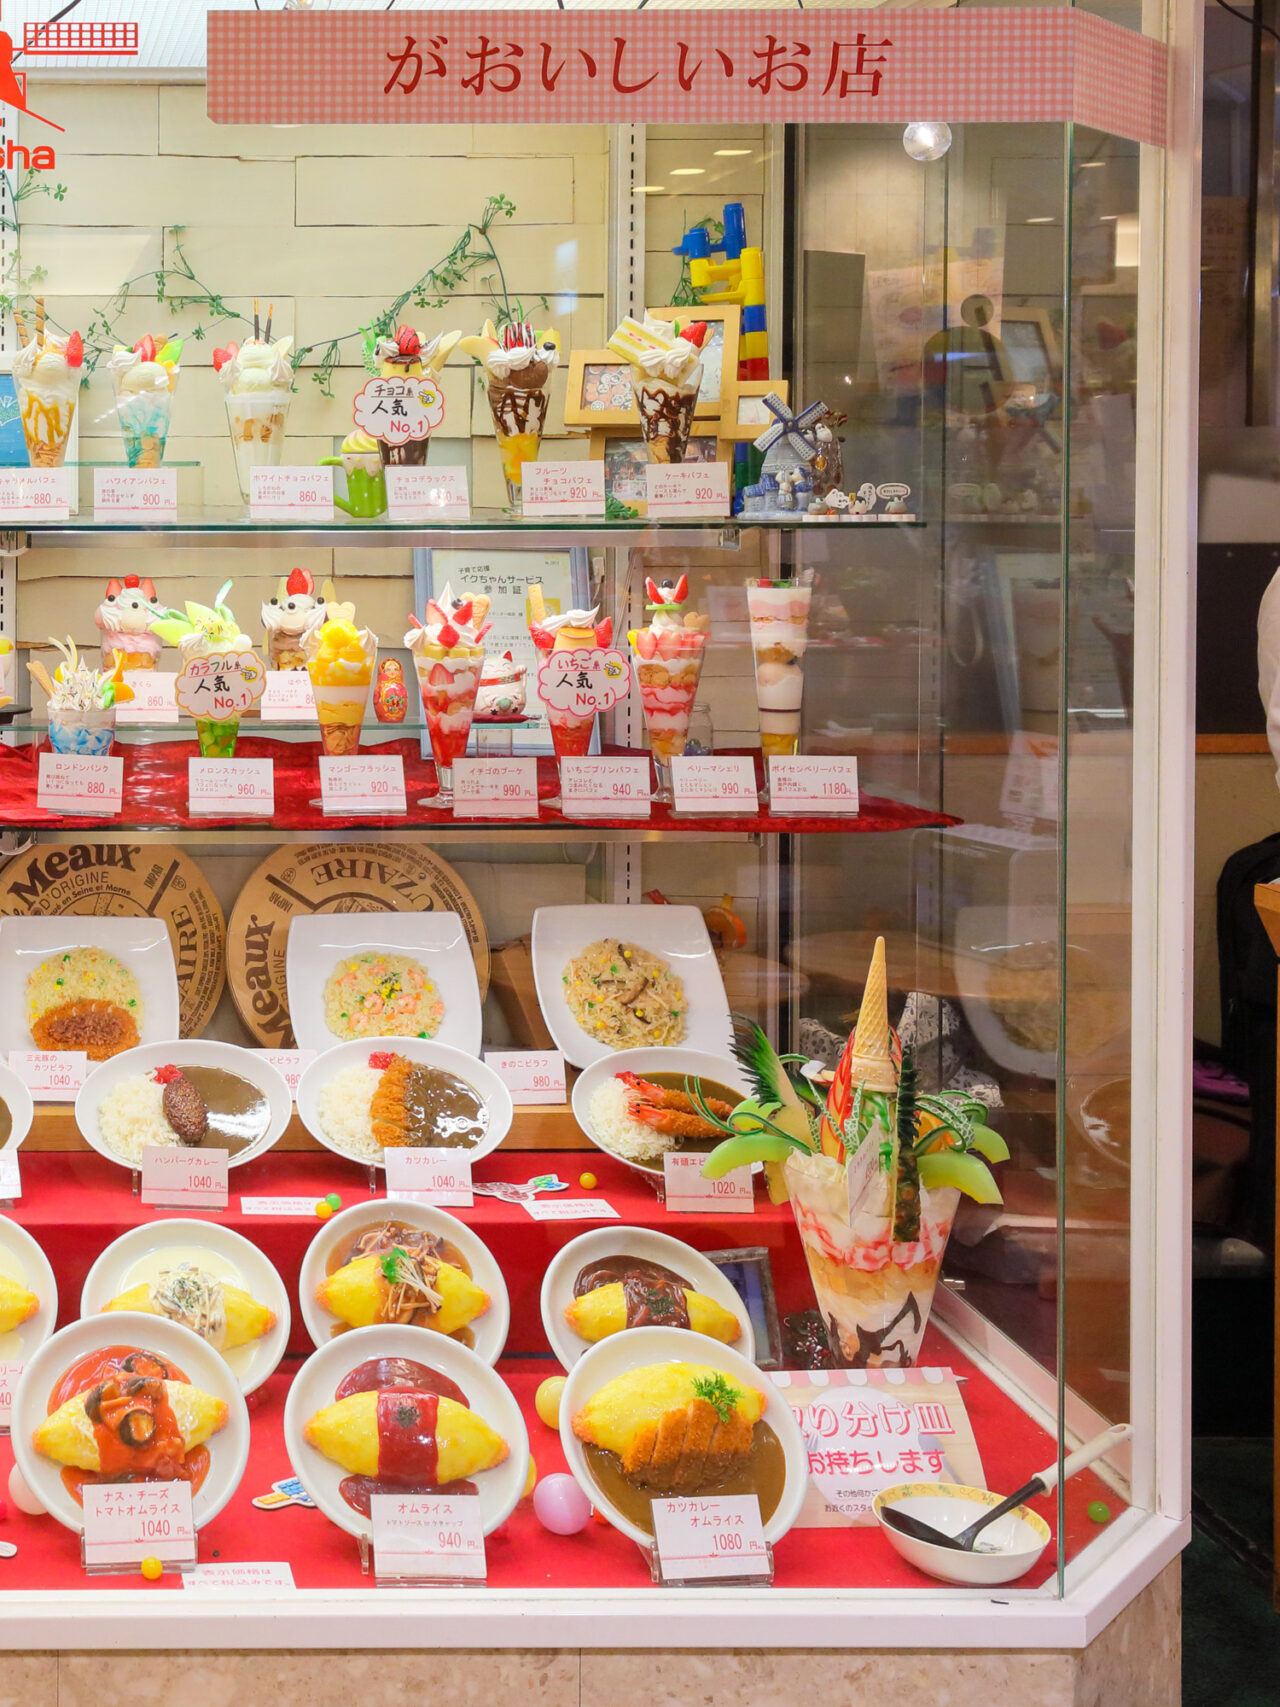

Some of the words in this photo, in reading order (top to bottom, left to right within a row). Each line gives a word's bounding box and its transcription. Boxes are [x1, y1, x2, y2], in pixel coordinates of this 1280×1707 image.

[383, 33, 893, 98] がおいしいお店
[371, 398, 409, 417] 人気
[389, 419, 424, 434] No.1
[535, 467, 567, 475] フルーツ
[665, 472, 709, 480] ケーキパフェ
[105, 477, 167, 485] ハワイアンパフェ
[253, 474, 330, 482] ホワイトチョコパフェ
[544, 476, 593, 485] チョコパフェ
[33, 493, 51, 505] 880
[142, 493, 160, 506] 900
[299, 491, 317, 503] 860
[570, 486, 589, 500] 920
[695, 487, 713, 500] 920
[193, 674, 231, 695] 人気
[555, 671, 593, 690] 人気
[147, 695, 164, 706] 860
[213, 692, 248, 710] No.1
[575, 692, 610, 706] No.1
[566, 766, 640, 775] いちごプリンパフェ
[87, 782, 105, 794] 880
[237, 784, 255, 796] 960
[371, 781, 389, 793] 920
[503, 784, 521, 796] 990
[612, 783, 631, 796] 940
[721, 782, 739, 795] 990
[823, 782, 847, 795] 1180
[7, 844, 142, 912] Meaux
[34, 1064, 73, 1072] カツピラフ
[500, 1058, 549, 1069] きのこピラフ
[48, 1074, 71, 1087] 1040
[532, 1075, 550, 1088] 980
[153, 1156, 219, 1167] ハンバーグカレー
[404, 1155, 448, 1165] カツカレー
[187, 1175, 212, 1189] 1040
[431, 1175, 456, 1189] 1040
[711, 1180, 737, 1195] 1020
[102, 1489, 170, 1501] ナス・チーズ
[94, 1504, 182, 1516] トマトオムライス
[397, 1503, 454, 1515] オムライス
[666, 1500, 722, 1514] カツカレー
[689, 1514, 745, 1527] オムライス
[140, 1519, 171, 1537] 1040
[437, 1531, 462, 1549] 940
[712, 1532, 743, 1552] 1080
